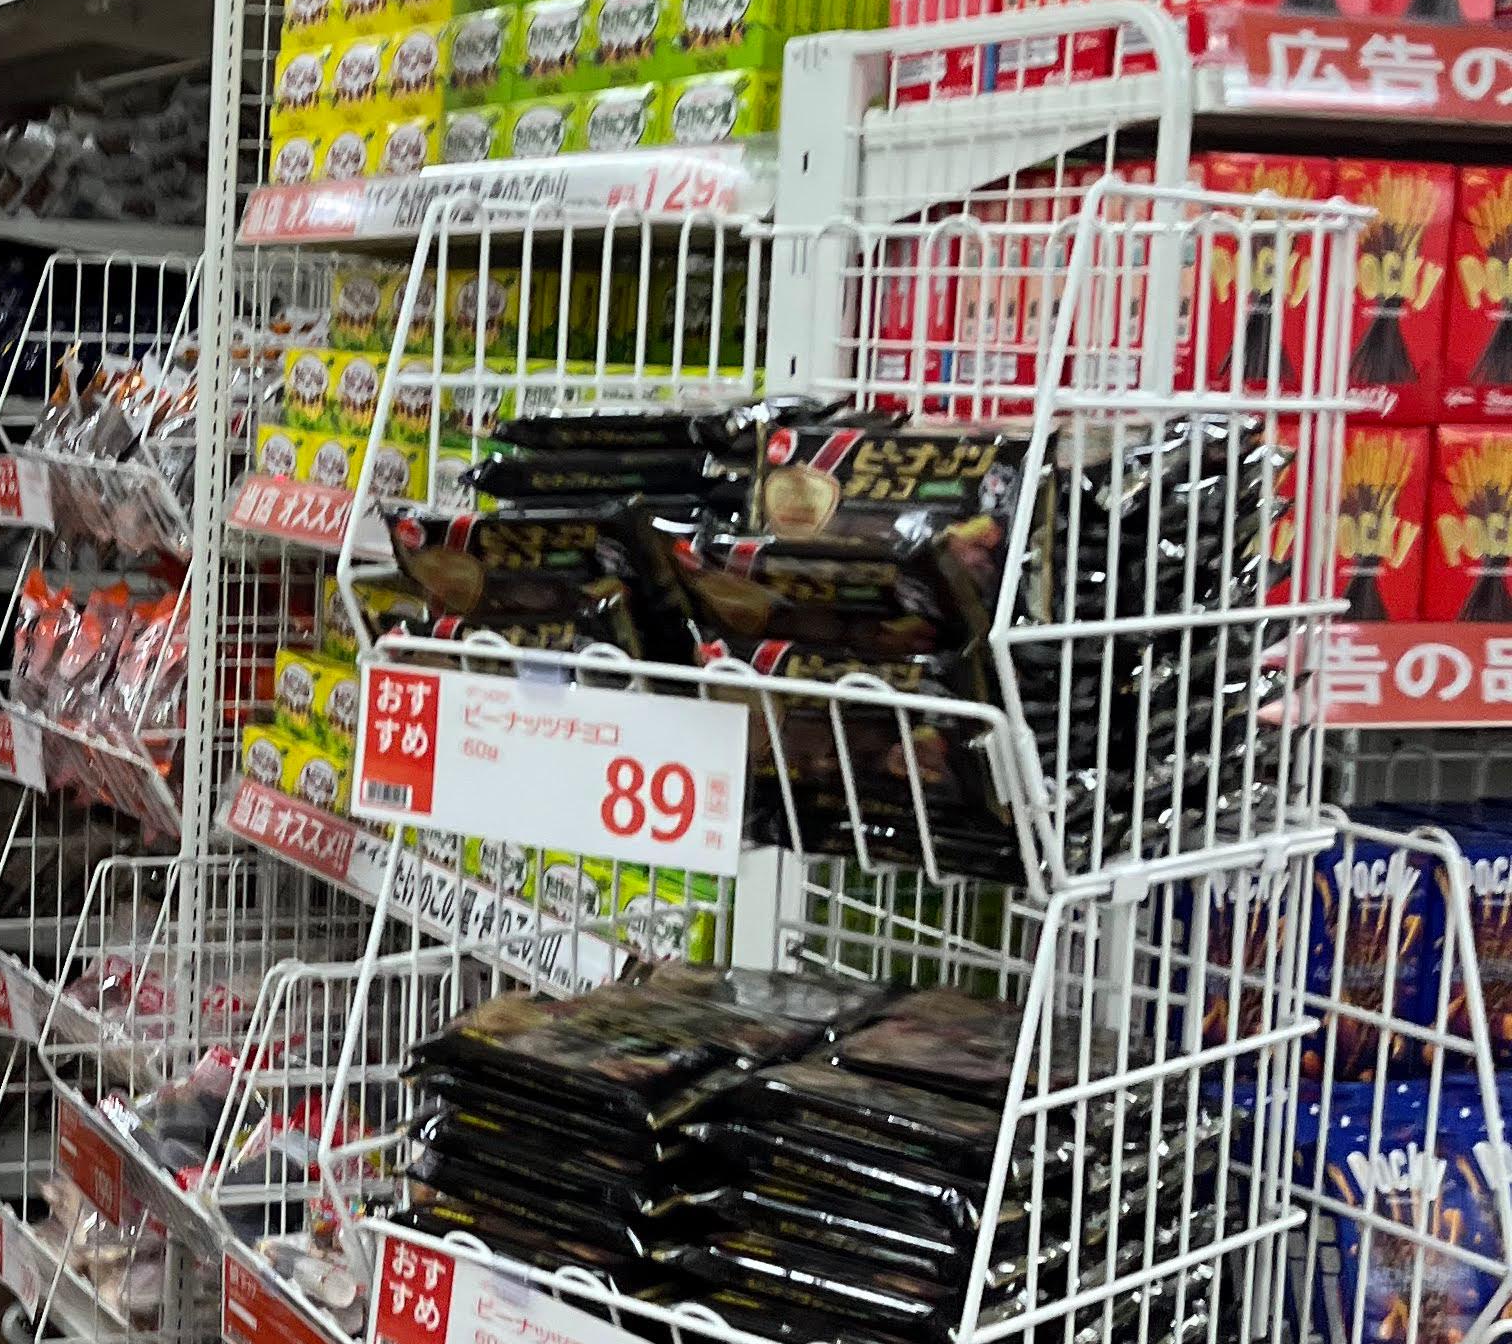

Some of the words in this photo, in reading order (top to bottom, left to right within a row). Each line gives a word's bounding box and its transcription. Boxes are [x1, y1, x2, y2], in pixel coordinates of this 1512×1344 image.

[1266, 29, 1512, 104] 広告の
[462, 703, 622, 747] ピーナッツチョコ
[600, 756, 697, 843] 89
